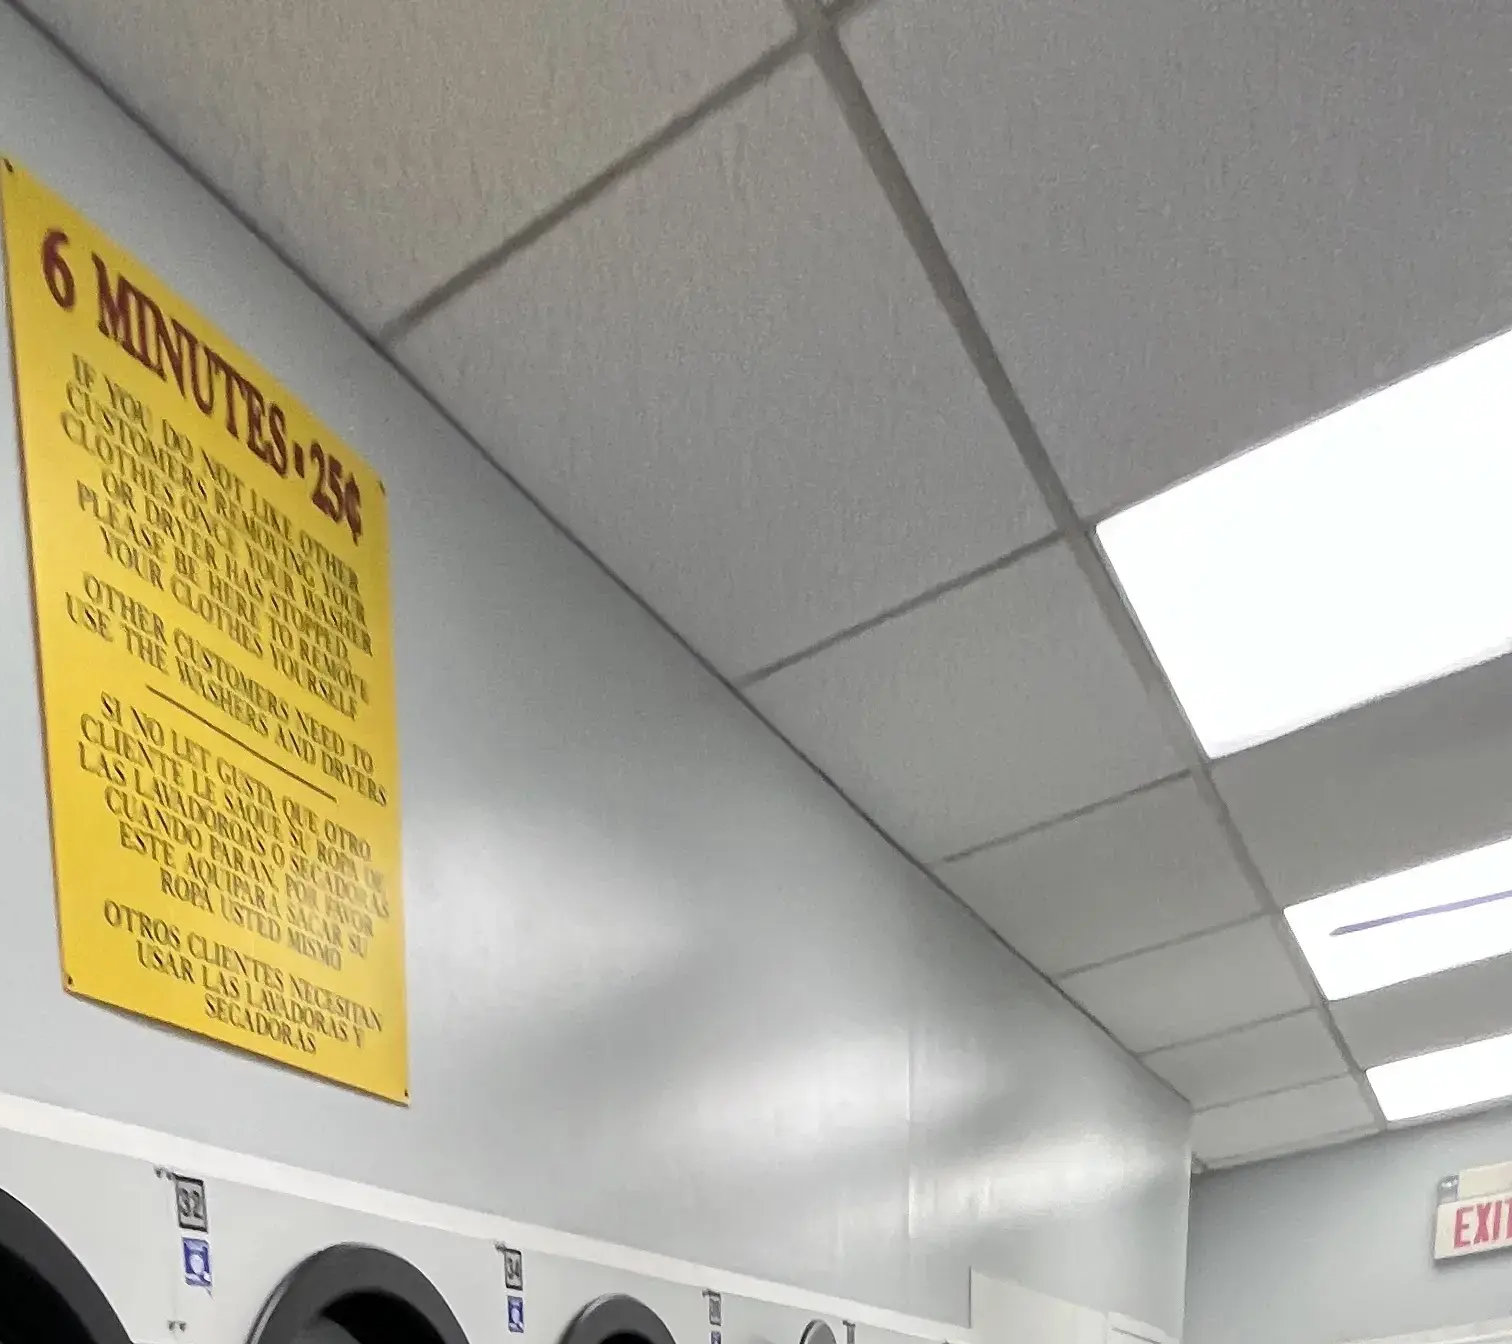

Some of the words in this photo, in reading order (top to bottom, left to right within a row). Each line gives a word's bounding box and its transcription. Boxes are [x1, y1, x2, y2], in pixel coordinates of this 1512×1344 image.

[41, 228, 75, 310] 6
[59, 405, 174, 512] CLOTHES
[181, 494, 235, 556] ONCE
[245, 541, 294, 601] YOUR
[302, 586, 372, 657] WASHER
[65, 379, 206, 503] CUSTOMERS
[214, 490, 315, 589] REMOVING
[321, 571, 365, 626] YOUR
[72, 352, 95, 394] IF
[103, 375, 149, 435] YOU
[162, 419, 193, 467] DO
[201, 449, 244, 506] NOT
[250, 488, 292, 544] LIKE
[299, 529, 360, 596] OTHER
[101, 465, 135, 513] OR
[144, 496, 217, 571] DRYER
[225, 554, 263, 604] HAS
[75, 478, 166, 565] PLEASE
[174, 546, 198, 587] BE
[207, 570, 260, 630] HERE
[268, 613, 293, 653] TO
[100, 526, 163, 591] YOUR
[170, 572, 262, 660] CLOTHES
[269, 642, 357, 722] YOURSELF
[64, 590, 112, 643] USE
[120, 623, 168, 677] THE
[175, 656, 269, 739] WASHERS
[274, 721, 316, 768] AND
[321, 749, 388, 811] DRYERS
[82, 568, 167, 646] OTHER
[173, 626, 289, 723] CUSTOMERS
[294, 706, 344, 759] NEED
[352, 742, 373, 777] TO
[77, 739, 127, 789] LAS
[271, 840, 284, 869] O
[79, 710, 184, 789] CLIENTE
[191, 769, 217, 806] LE
[224, 788, 283, 843] SAQUE
[289, 825, 306, 856] SU
[316, 839, 357, 882] ROPA
[99, 689, 123, 728] SI
[130, 706, 164, 750] NO
[216, 755, 276, 813] GUSTA
[281, 793, 319, 837] QUE
[324, 817, 371, 864] OTRO
[104, 782, 202, 854] CUANDO
[118, 819, 176, 871] ESTE
[286, 900, 343, 948] SACAR
[347, 930, 366, 959] SU
[159, 868, 213, 915] ROPA
[220, 895, 280, 944] USTED
[287, 926, 342, 972] MISMO
[102, 895, 181, 952] OTROS
[187, 930, 284, 992] CLIENTES
[289, 973, 383, 1033] NECESITAN
[136, 937, 194, 984] USAR
[201, 964, 239, 1001] LAS
[246, 981, 347, 1043] LAVADORAS
[347, 1022, 365, 1050] Y
[204, 992, 316, 1056] SECADORAS
[180, 1187, 204, 1219] 32
